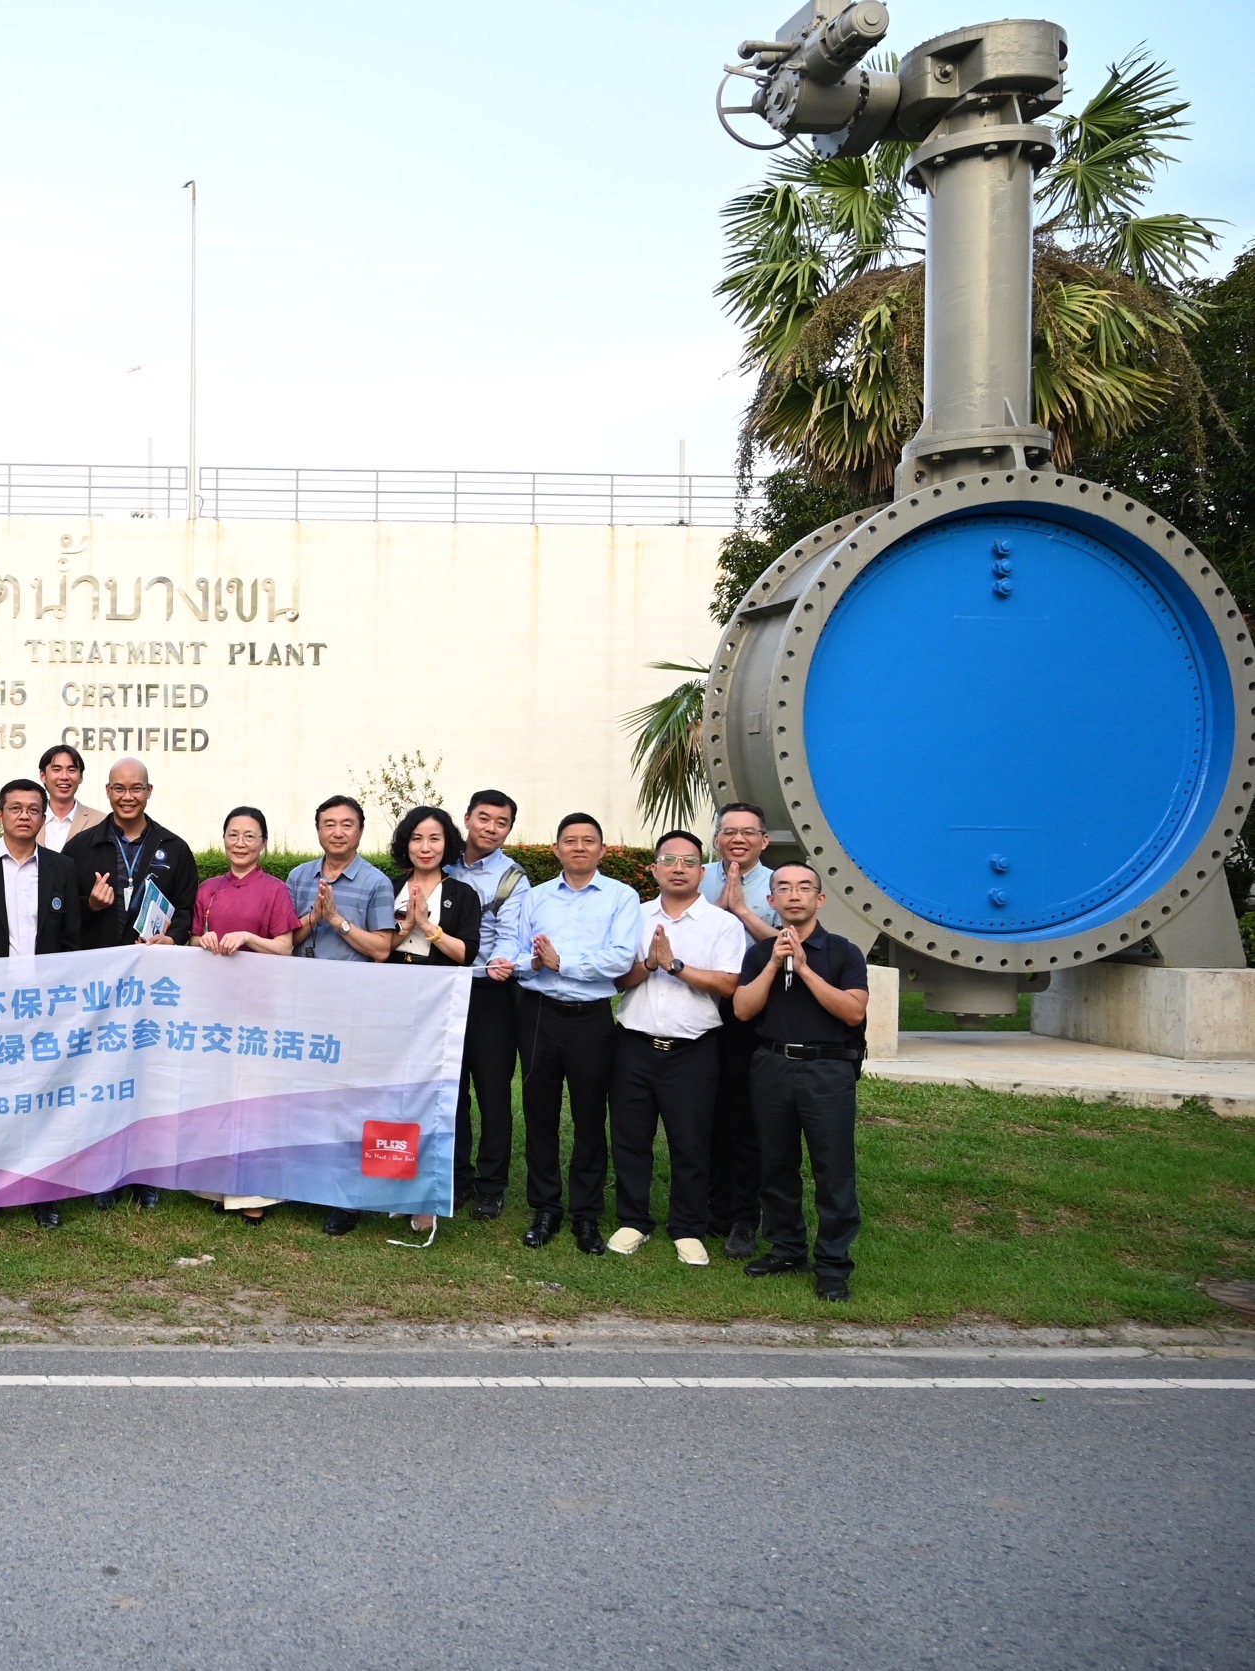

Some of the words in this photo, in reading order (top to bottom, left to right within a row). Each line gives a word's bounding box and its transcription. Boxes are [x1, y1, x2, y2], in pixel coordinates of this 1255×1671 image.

[24, 639, 207, 665] TREATMENT
[228, 642, 327, 666] PLANT
[61, 681, 209, 708] CERTIFIED
[61, 726, 209, 752] CERTIFIED
